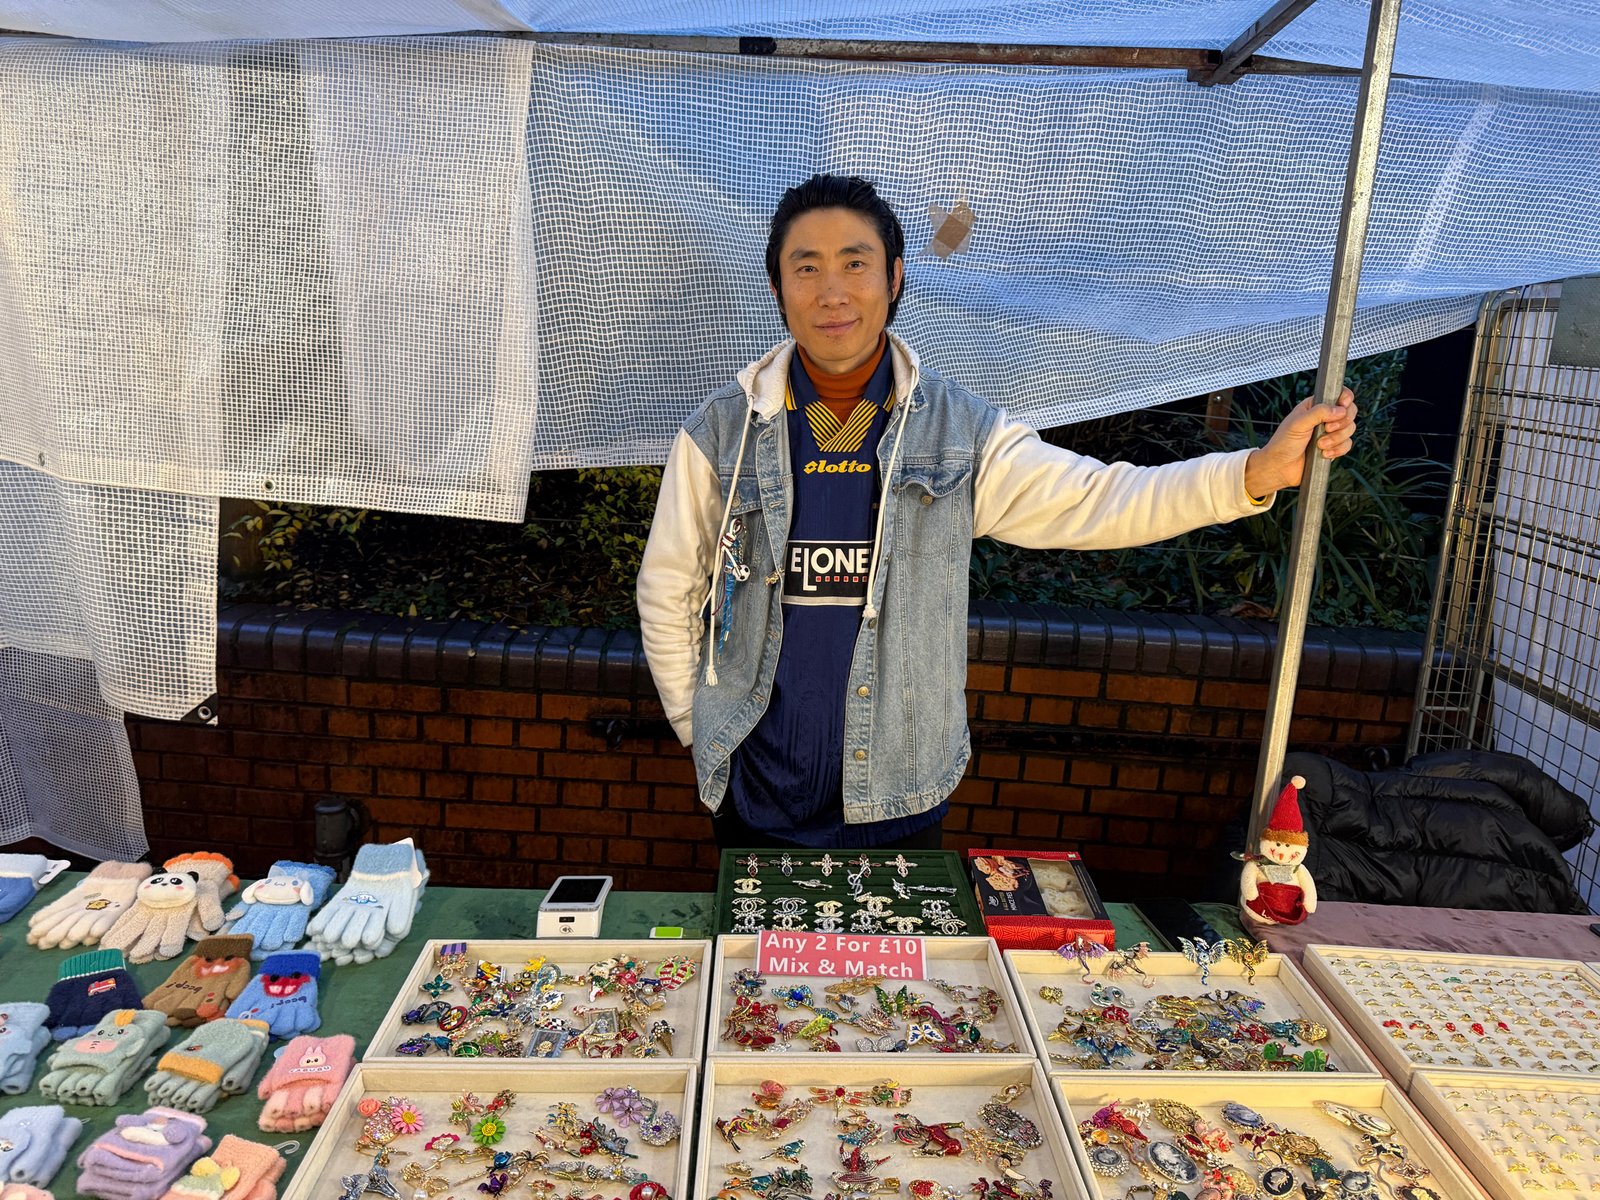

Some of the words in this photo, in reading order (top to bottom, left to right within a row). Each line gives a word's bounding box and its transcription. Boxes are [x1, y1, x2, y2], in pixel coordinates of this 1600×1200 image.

[817, 460, 871, 473] lotto
[790, 547, 872, 592] ELONE
[765, 933, 808, 952] Any
[815, 935, 827, 951] 2
[836, 936, 871, 952] For
[879, 938, 917, 955] £10
[769, 956, 809, 974] Mix
[817, 959, 836, 975] &
[845, 960, 913, 978] Match
